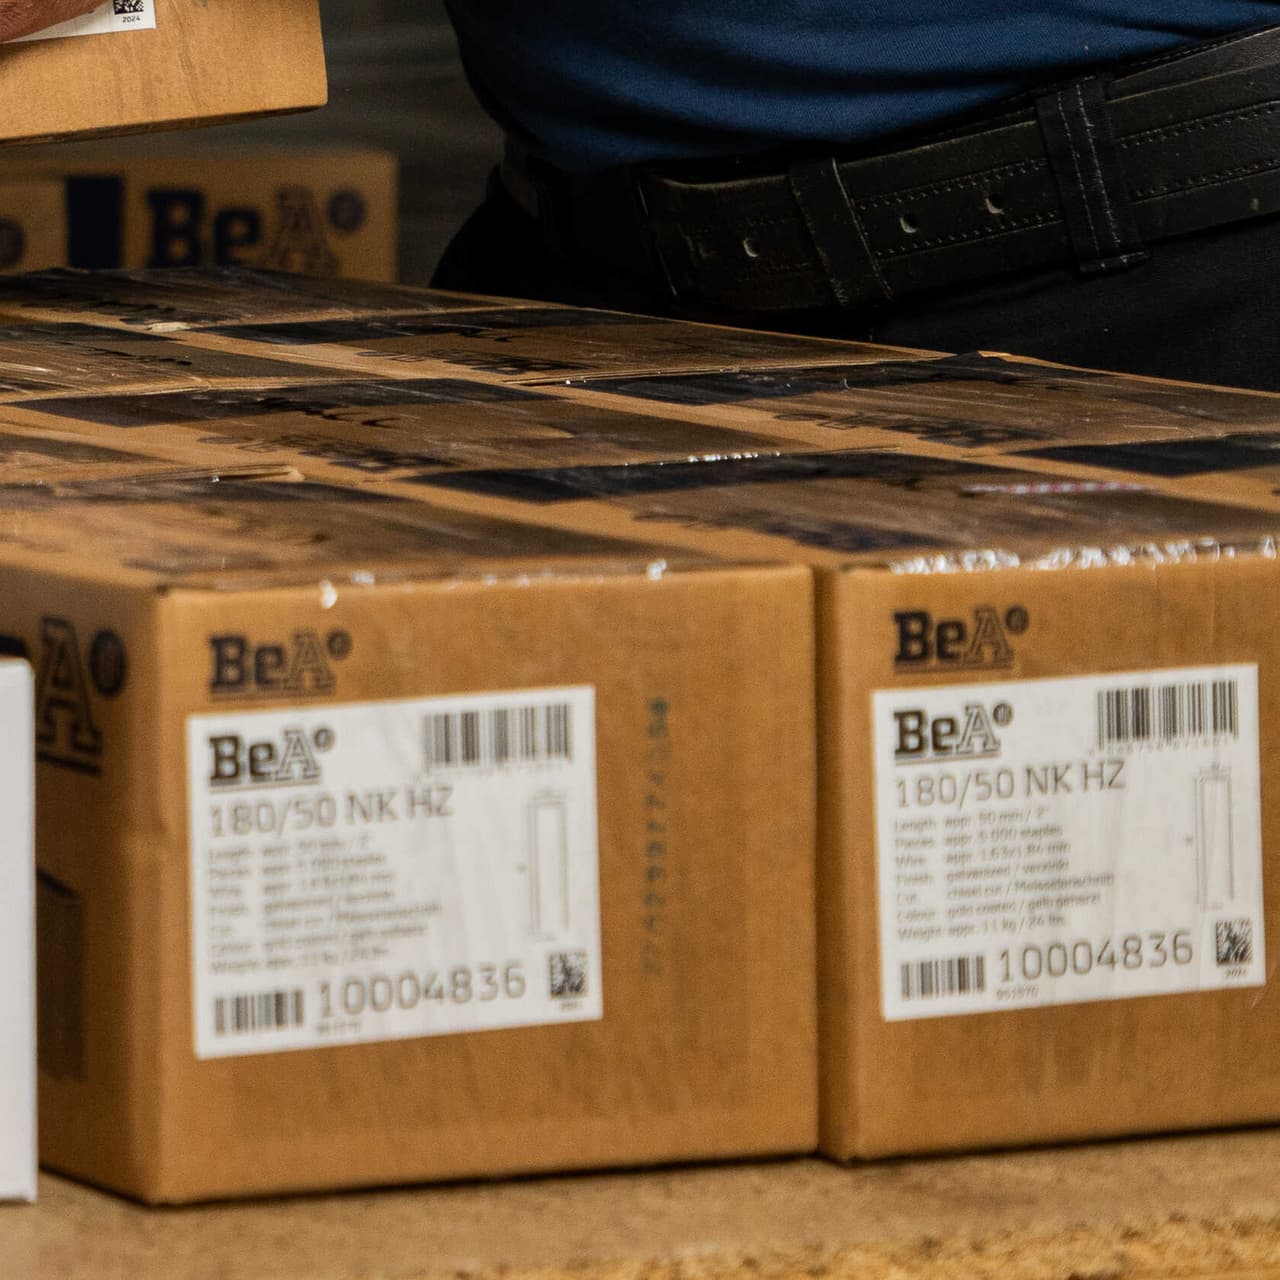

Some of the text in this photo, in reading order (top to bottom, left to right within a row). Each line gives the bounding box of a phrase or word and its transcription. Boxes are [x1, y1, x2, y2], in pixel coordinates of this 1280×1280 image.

[209, 629, 337, 692] BeA
[894, 606, 1014, 667] BeA
[209, 728, 321, 784] BeA
[894, 704, 1000, 757] BeA
[895, 760, 1126, 810] 180/50 NK HZ
[209, 786, 454, 839] 180/50 NK HZ
[996, 931, 1194, 984] 10004836
[316, 960, 528, 1017] 10004836
